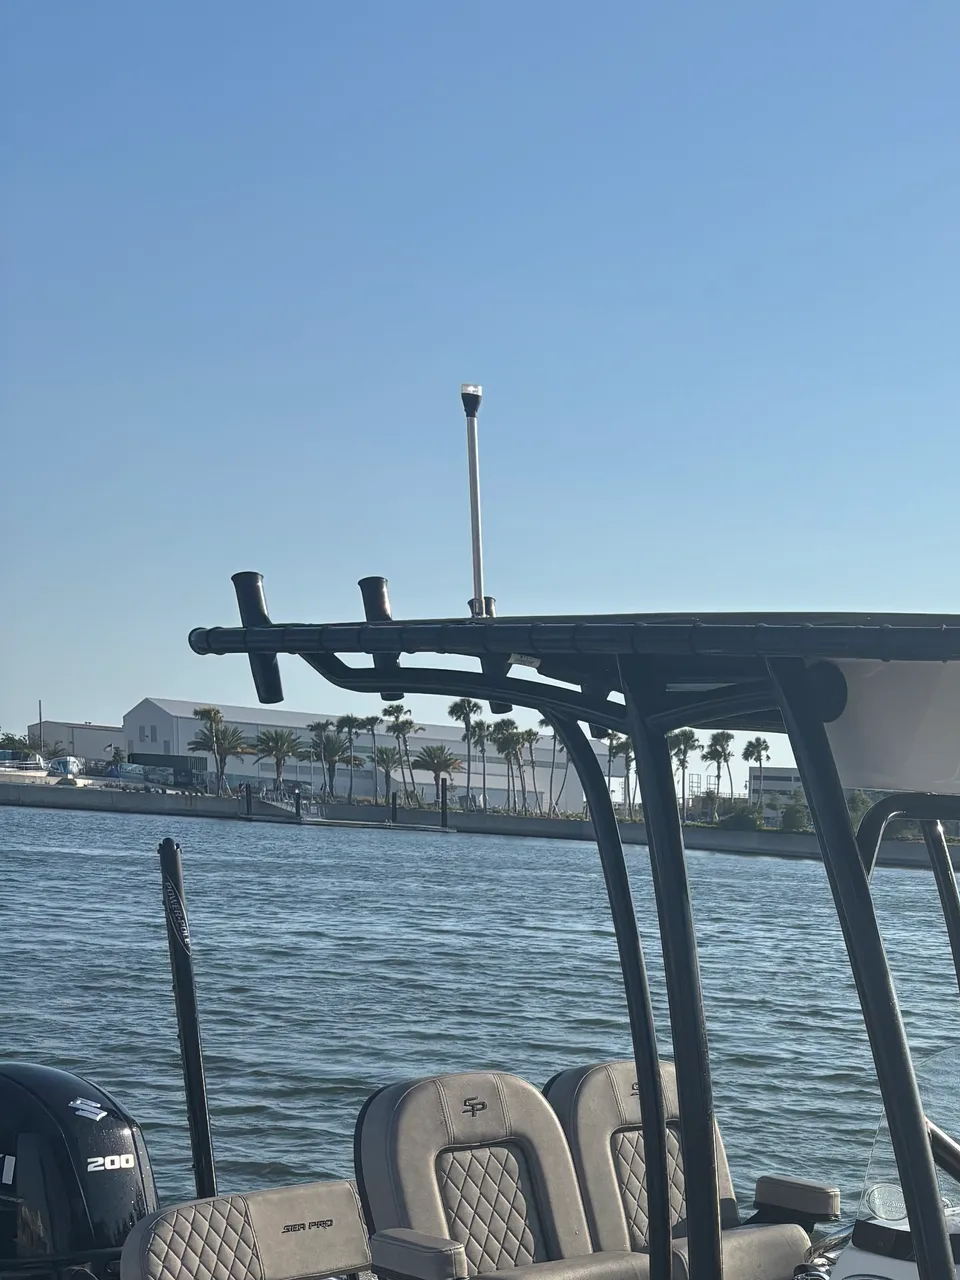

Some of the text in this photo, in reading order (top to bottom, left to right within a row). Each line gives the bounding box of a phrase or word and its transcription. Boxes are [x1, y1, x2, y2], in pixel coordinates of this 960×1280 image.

[86, 1153, 135, 1172] 200
[281, 1218, 334, 1234] SEA PRO
